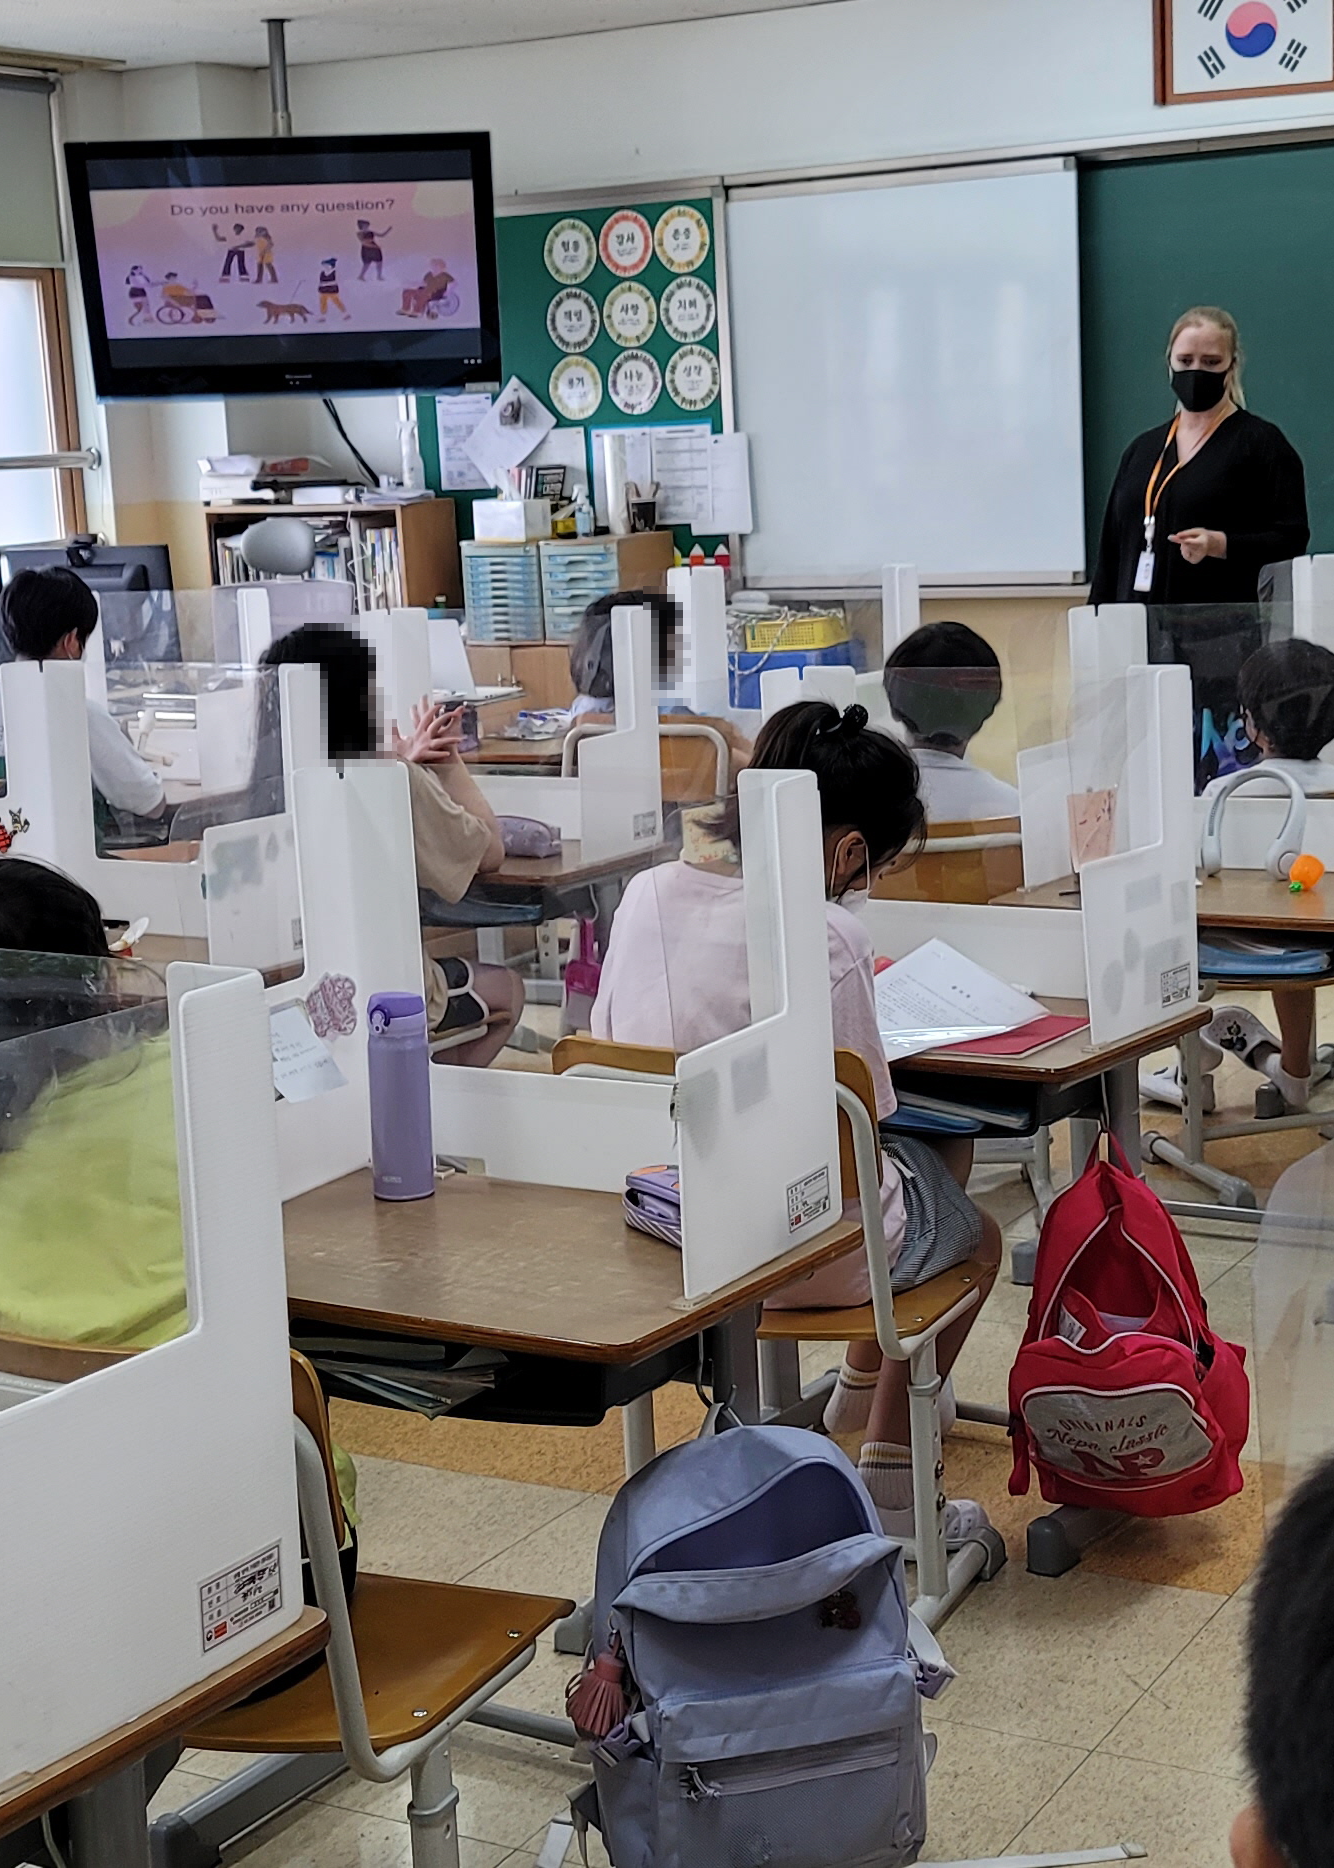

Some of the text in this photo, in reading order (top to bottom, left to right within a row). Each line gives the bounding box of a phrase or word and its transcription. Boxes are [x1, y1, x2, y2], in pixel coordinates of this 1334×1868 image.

[170, 199, 395, 217] Do you have any question?
[620, 303, 639, 316] 사랑
[1058, 1414, 1147, 1433] ORIGINALS
